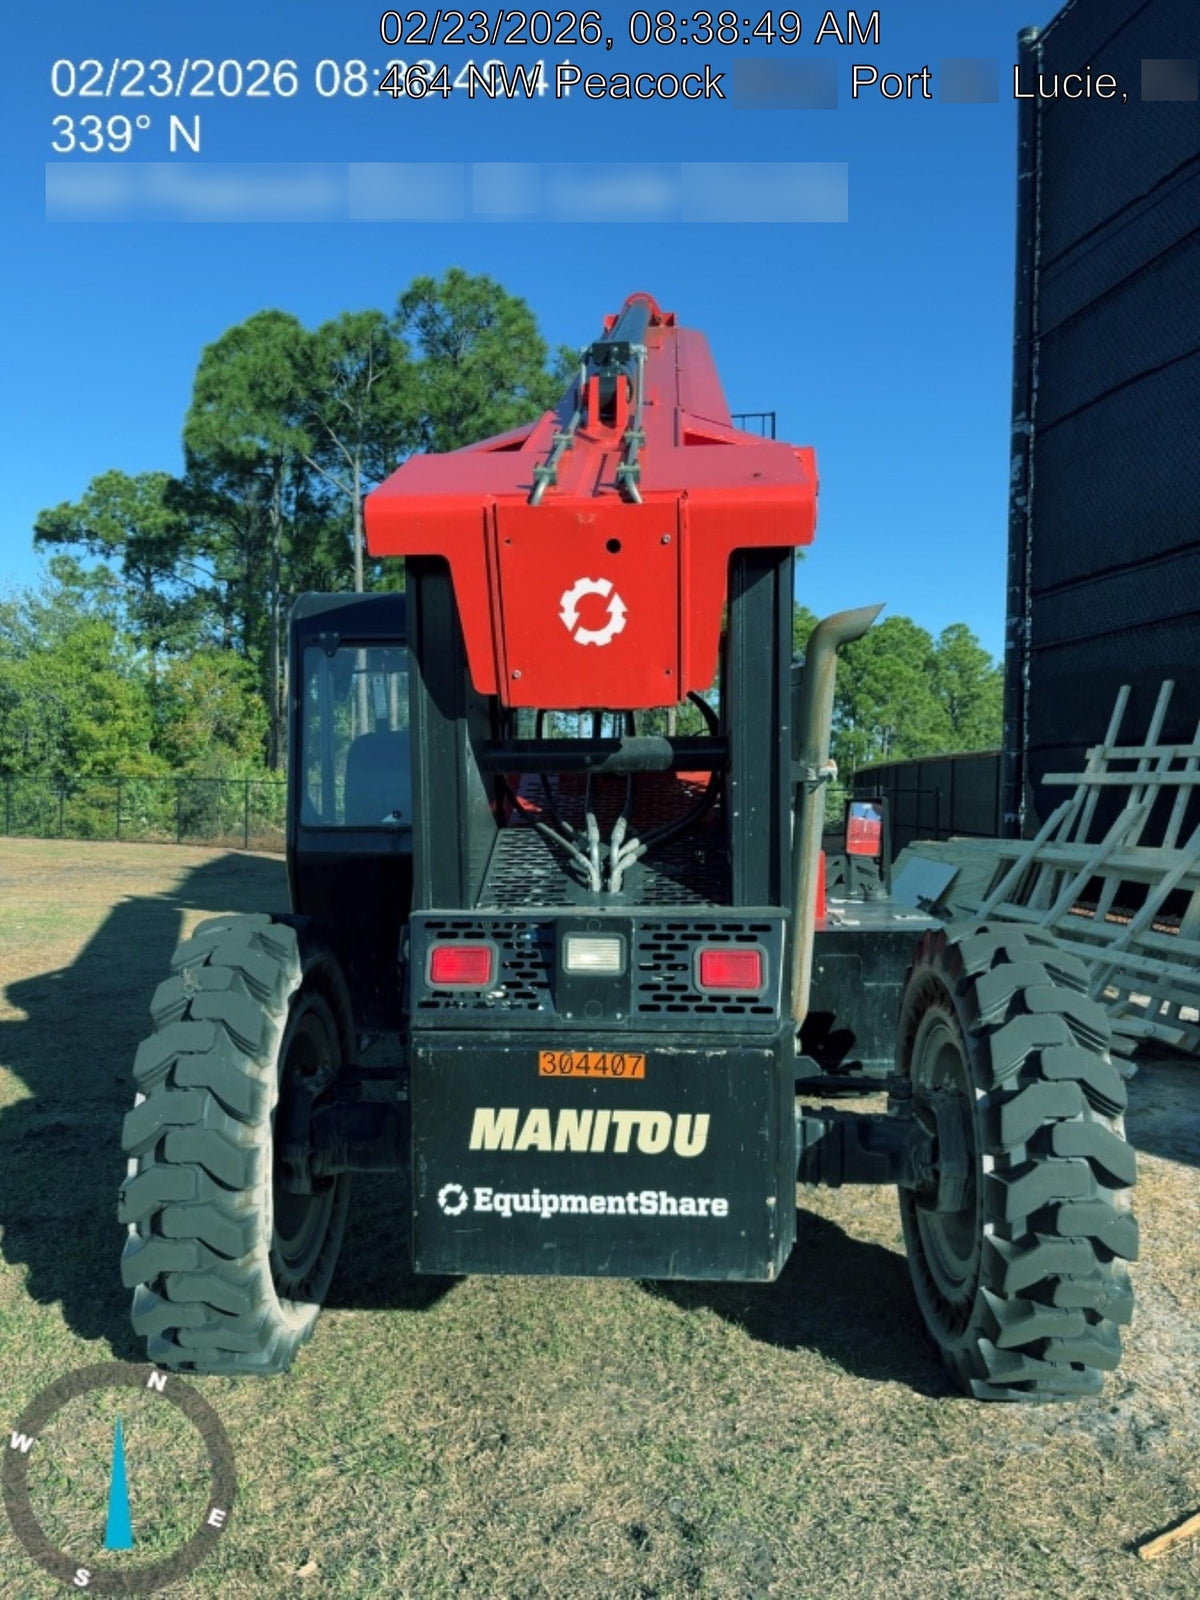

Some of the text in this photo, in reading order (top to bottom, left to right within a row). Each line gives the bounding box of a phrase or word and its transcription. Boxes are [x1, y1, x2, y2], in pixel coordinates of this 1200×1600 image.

[542, 1052, 643, 1076] 304407
[469, 1107, 710, 1157] MANITOU
[473, 1187, 729, 1219] EquipmentShare
